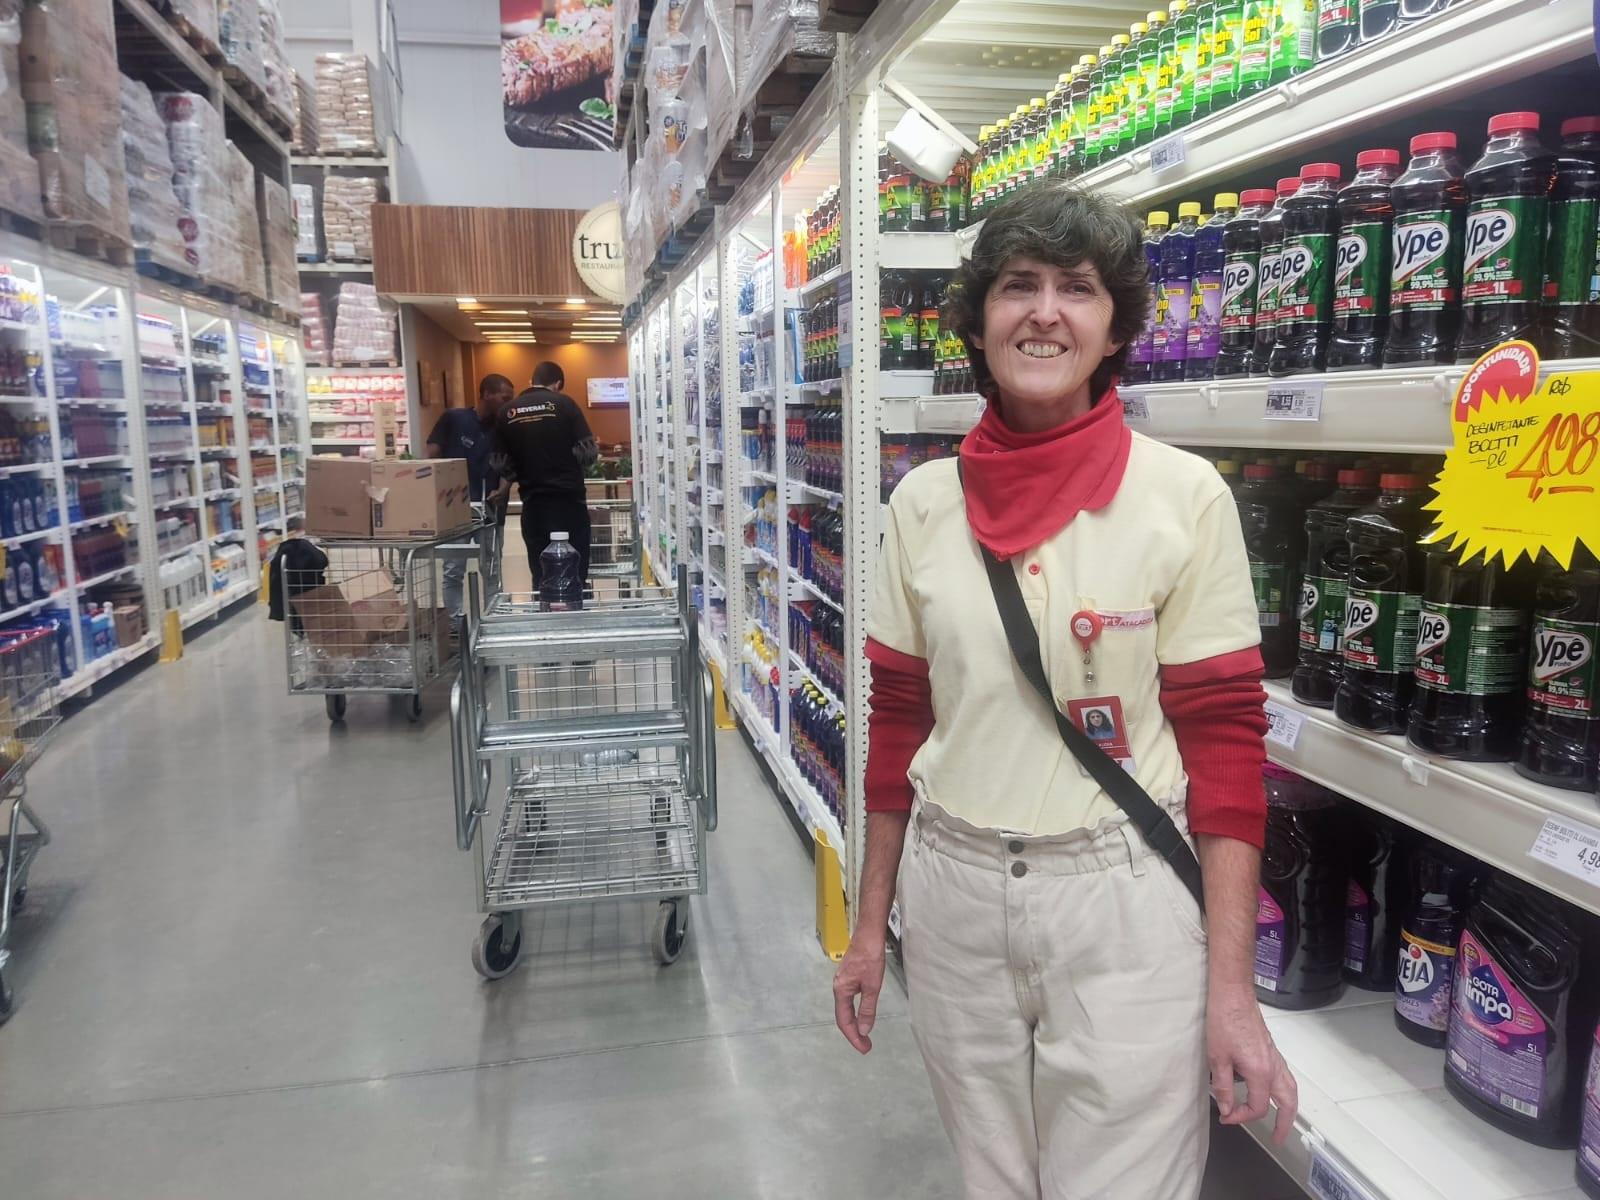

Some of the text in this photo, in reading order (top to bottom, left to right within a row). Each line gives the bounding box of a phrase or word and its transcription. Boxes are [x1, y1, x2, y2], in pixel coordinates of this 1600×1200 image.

[1337, 241, 1361, 268] pê
[1395, 228, 1443, 269] Ypê
[1281, 252, 1306, 279] pê
[1431, 289, 1446, 301] 1L
[1493, 281, 1509, 294] 1L
[1348, 298, 1361, 310] 1L
[1238, 316, 1250, 326] 1L
[1461, 348, 1531, 404] OPORTUNIDADE
[1466, 416, 1539, 438] DESINFETANTE
[1367, 655, 1378, 665] 2L
[1537, 634, 1584, 668] Ypê
[1437, 674, 1449, 686] 2L
[1574, 698, 1590, 711] 2L
[1465, 976, 1513, 1020] limpa
[1472, 976, 1499, 998] GOTA
